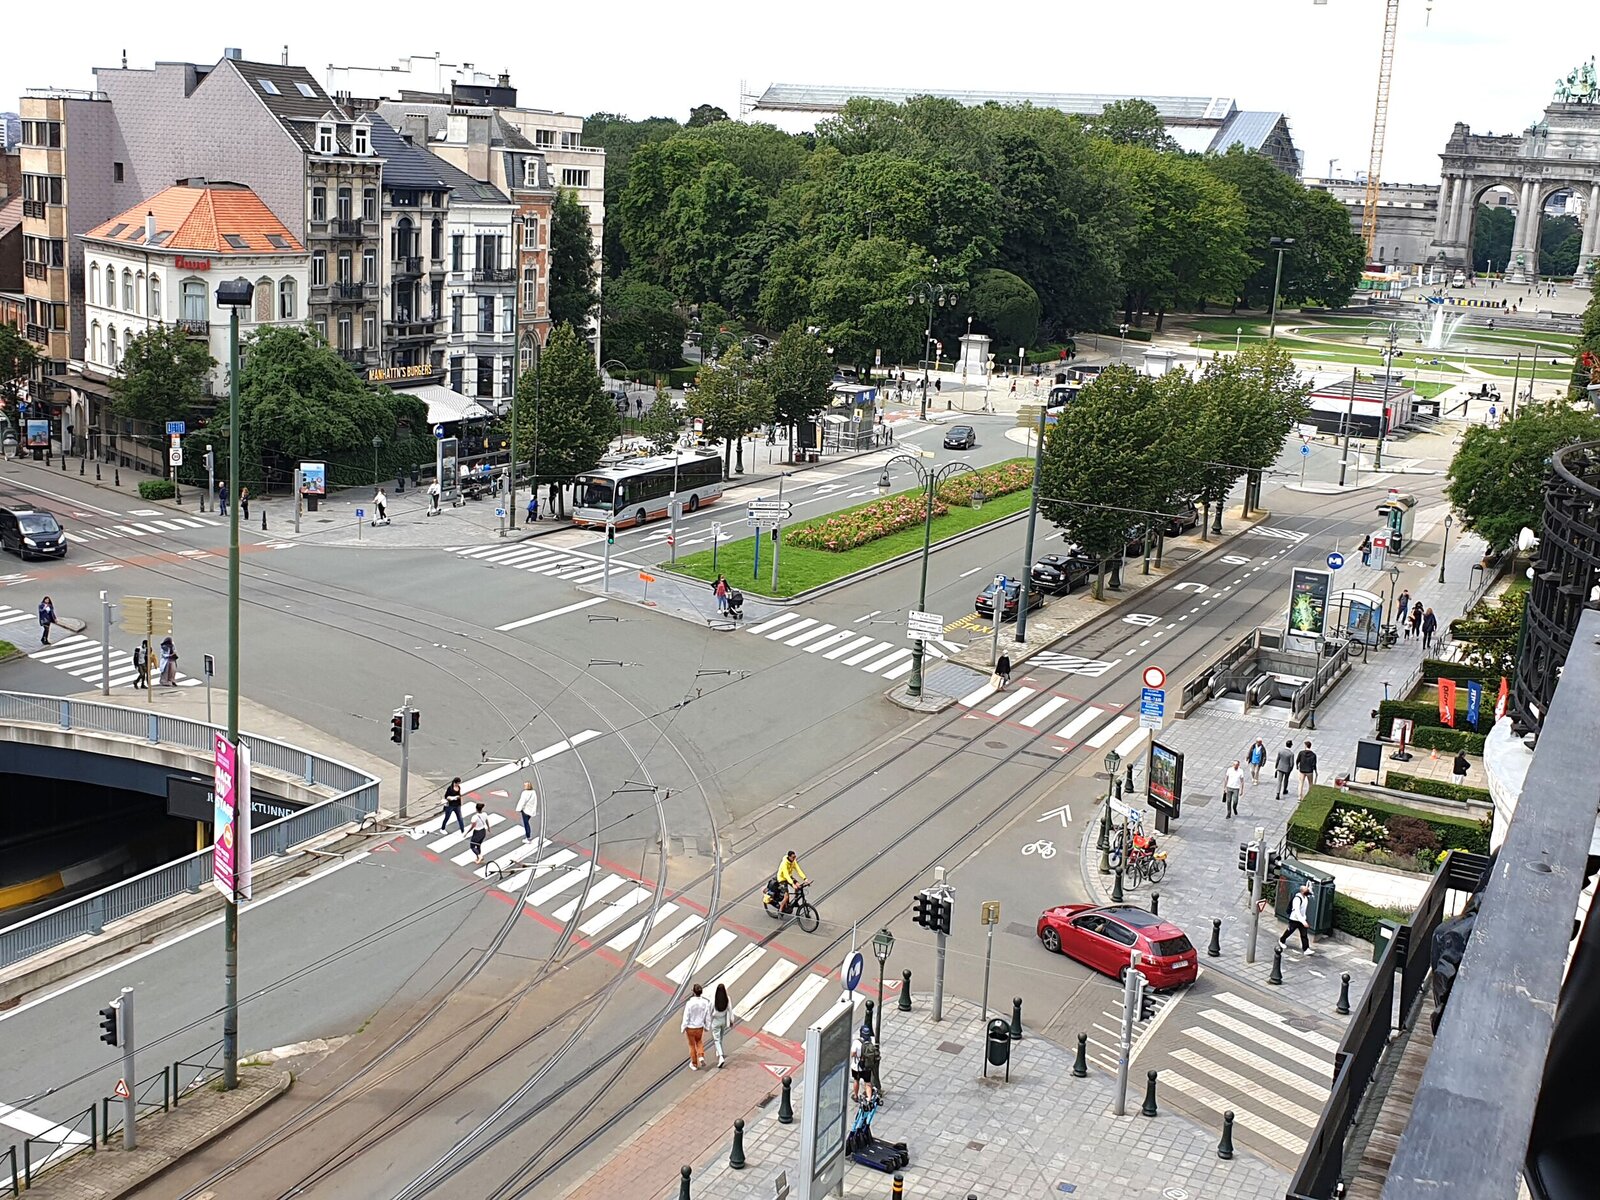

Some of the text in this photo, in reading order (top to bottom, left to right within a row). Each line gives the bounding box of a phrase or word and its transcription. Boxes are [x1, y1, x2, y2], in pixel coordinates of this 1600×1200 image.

[368, 364, 432, 381] MANHATTN'S BURGERS
[961, 622, 996, 634] TAXI
[848, 960, 861, 982] M
